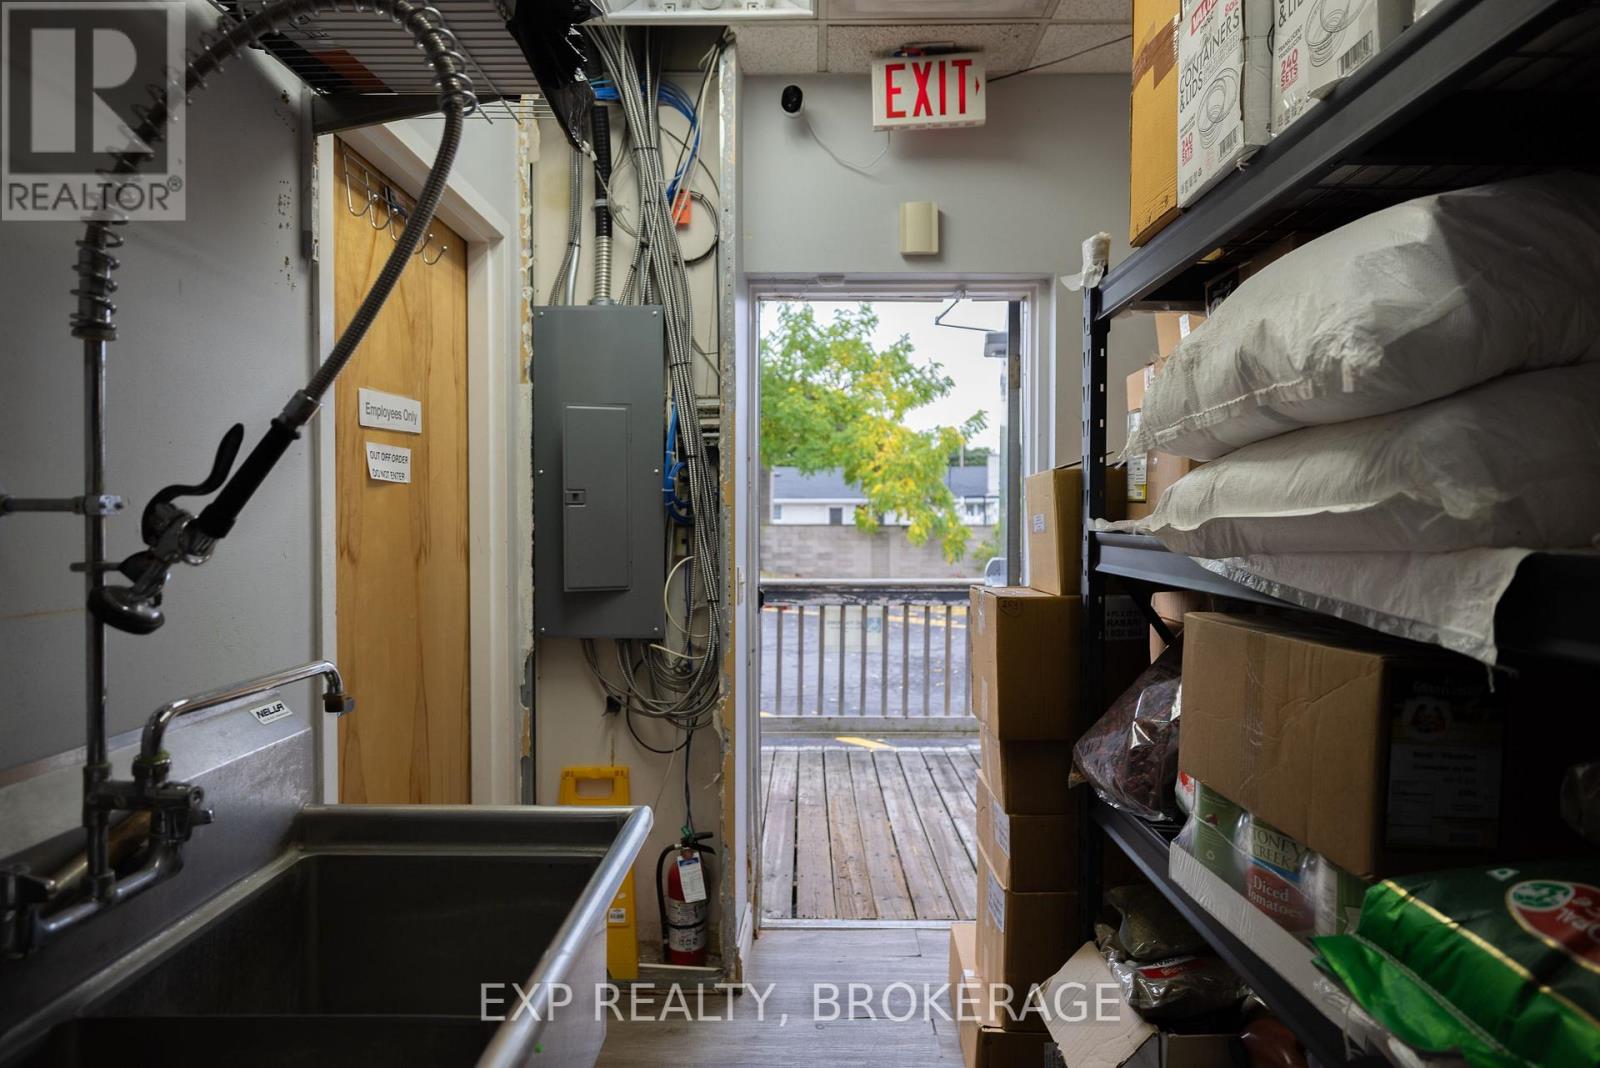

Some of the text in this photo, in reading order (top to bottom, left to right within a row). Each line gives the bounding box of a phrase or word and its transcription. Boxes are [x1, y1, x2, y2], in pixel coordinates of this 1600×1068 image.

[1179, 7, 1240, 94] CONTAINERS
[1281, 48, 1299, 76] 240
[1280, 63, 1299, 88] SETS
[884, 59, 973, 119] EXIT
[365, 402, 417, 425] Employees Only
[370, 451, 380, 460] OUT
[391, 454, 408, 464] ORDER
[256, 703, 285, 718] NELLA
[1253, 875, 1290, 903] Diced
